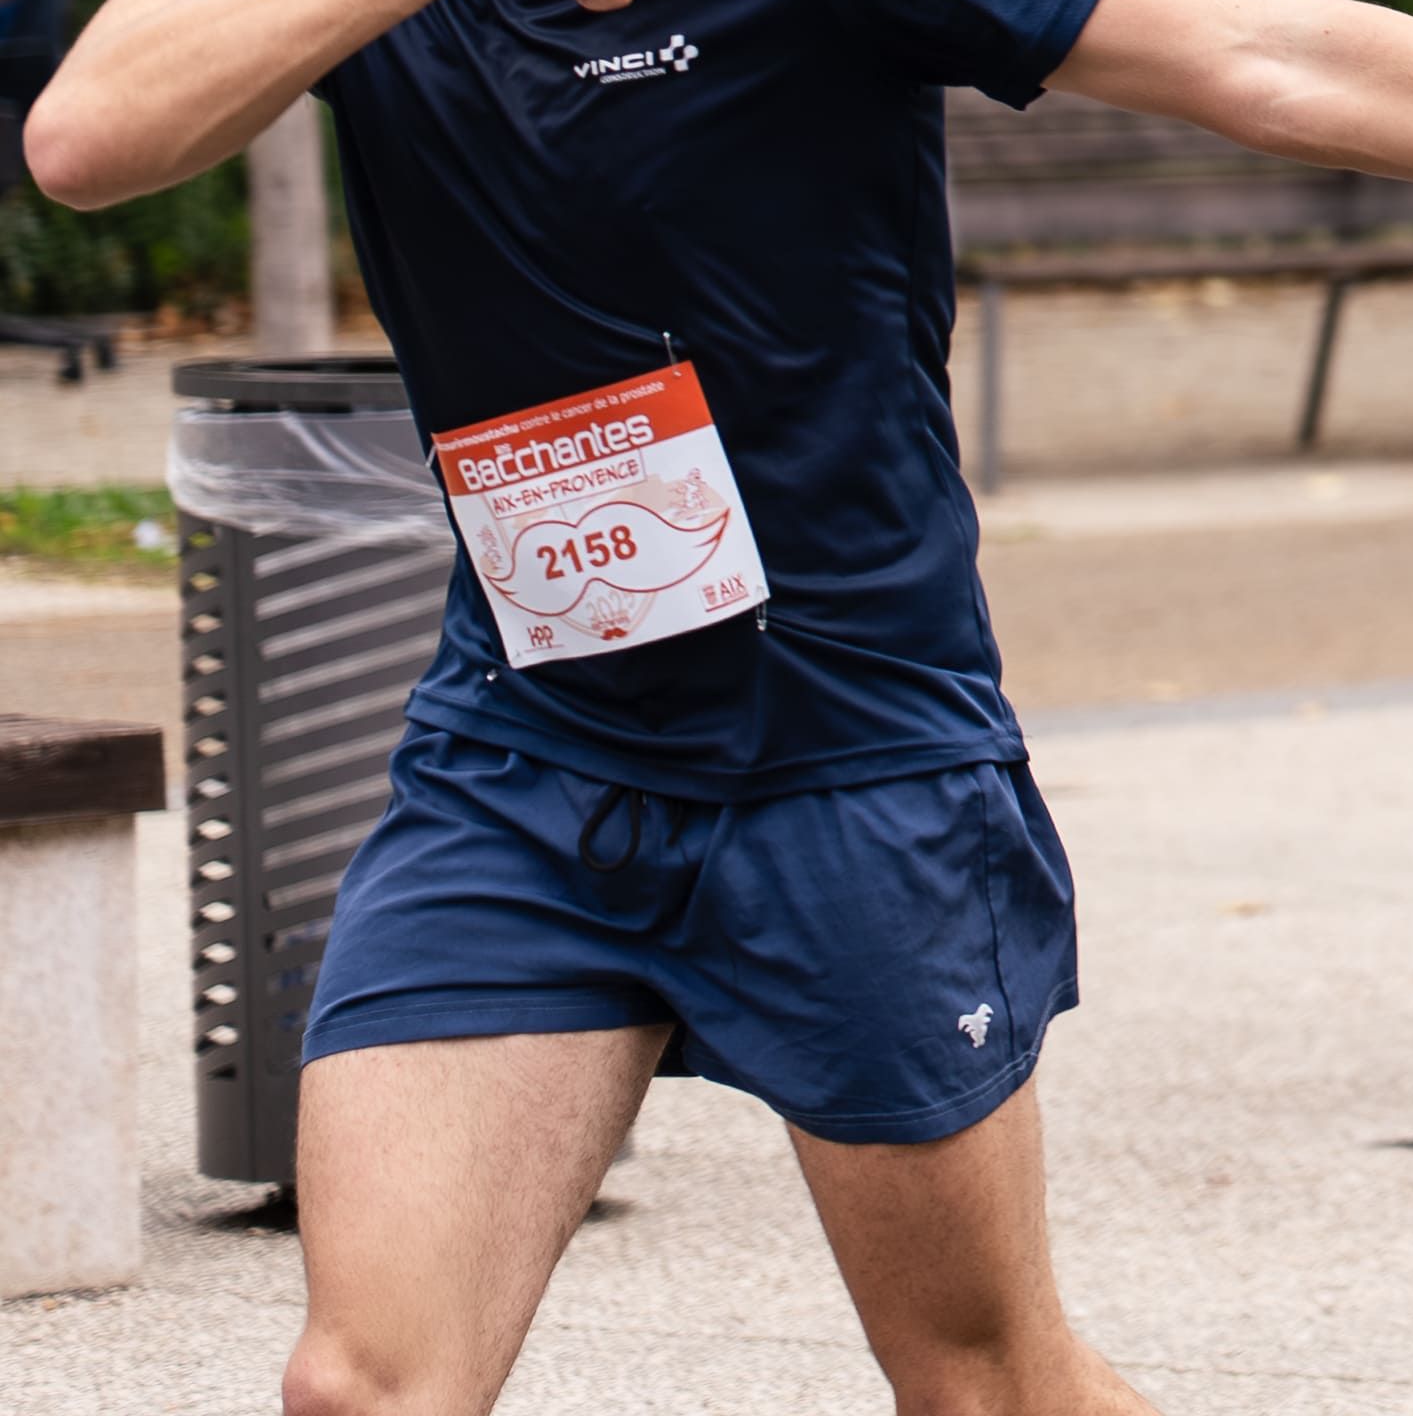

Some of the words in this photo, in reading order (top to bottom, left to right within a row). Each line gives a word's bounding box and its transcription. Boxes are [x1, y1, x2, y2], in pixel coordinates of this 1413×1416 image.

[573, 50, 655, 79] VINCI
[457, 414, 655, 491] Bacchantes
[492, 459, 641, 516] AIX-EN-PROVENCE
[536, 524, 638, 581] 2158
[719, 575, 746, 597] AIX
